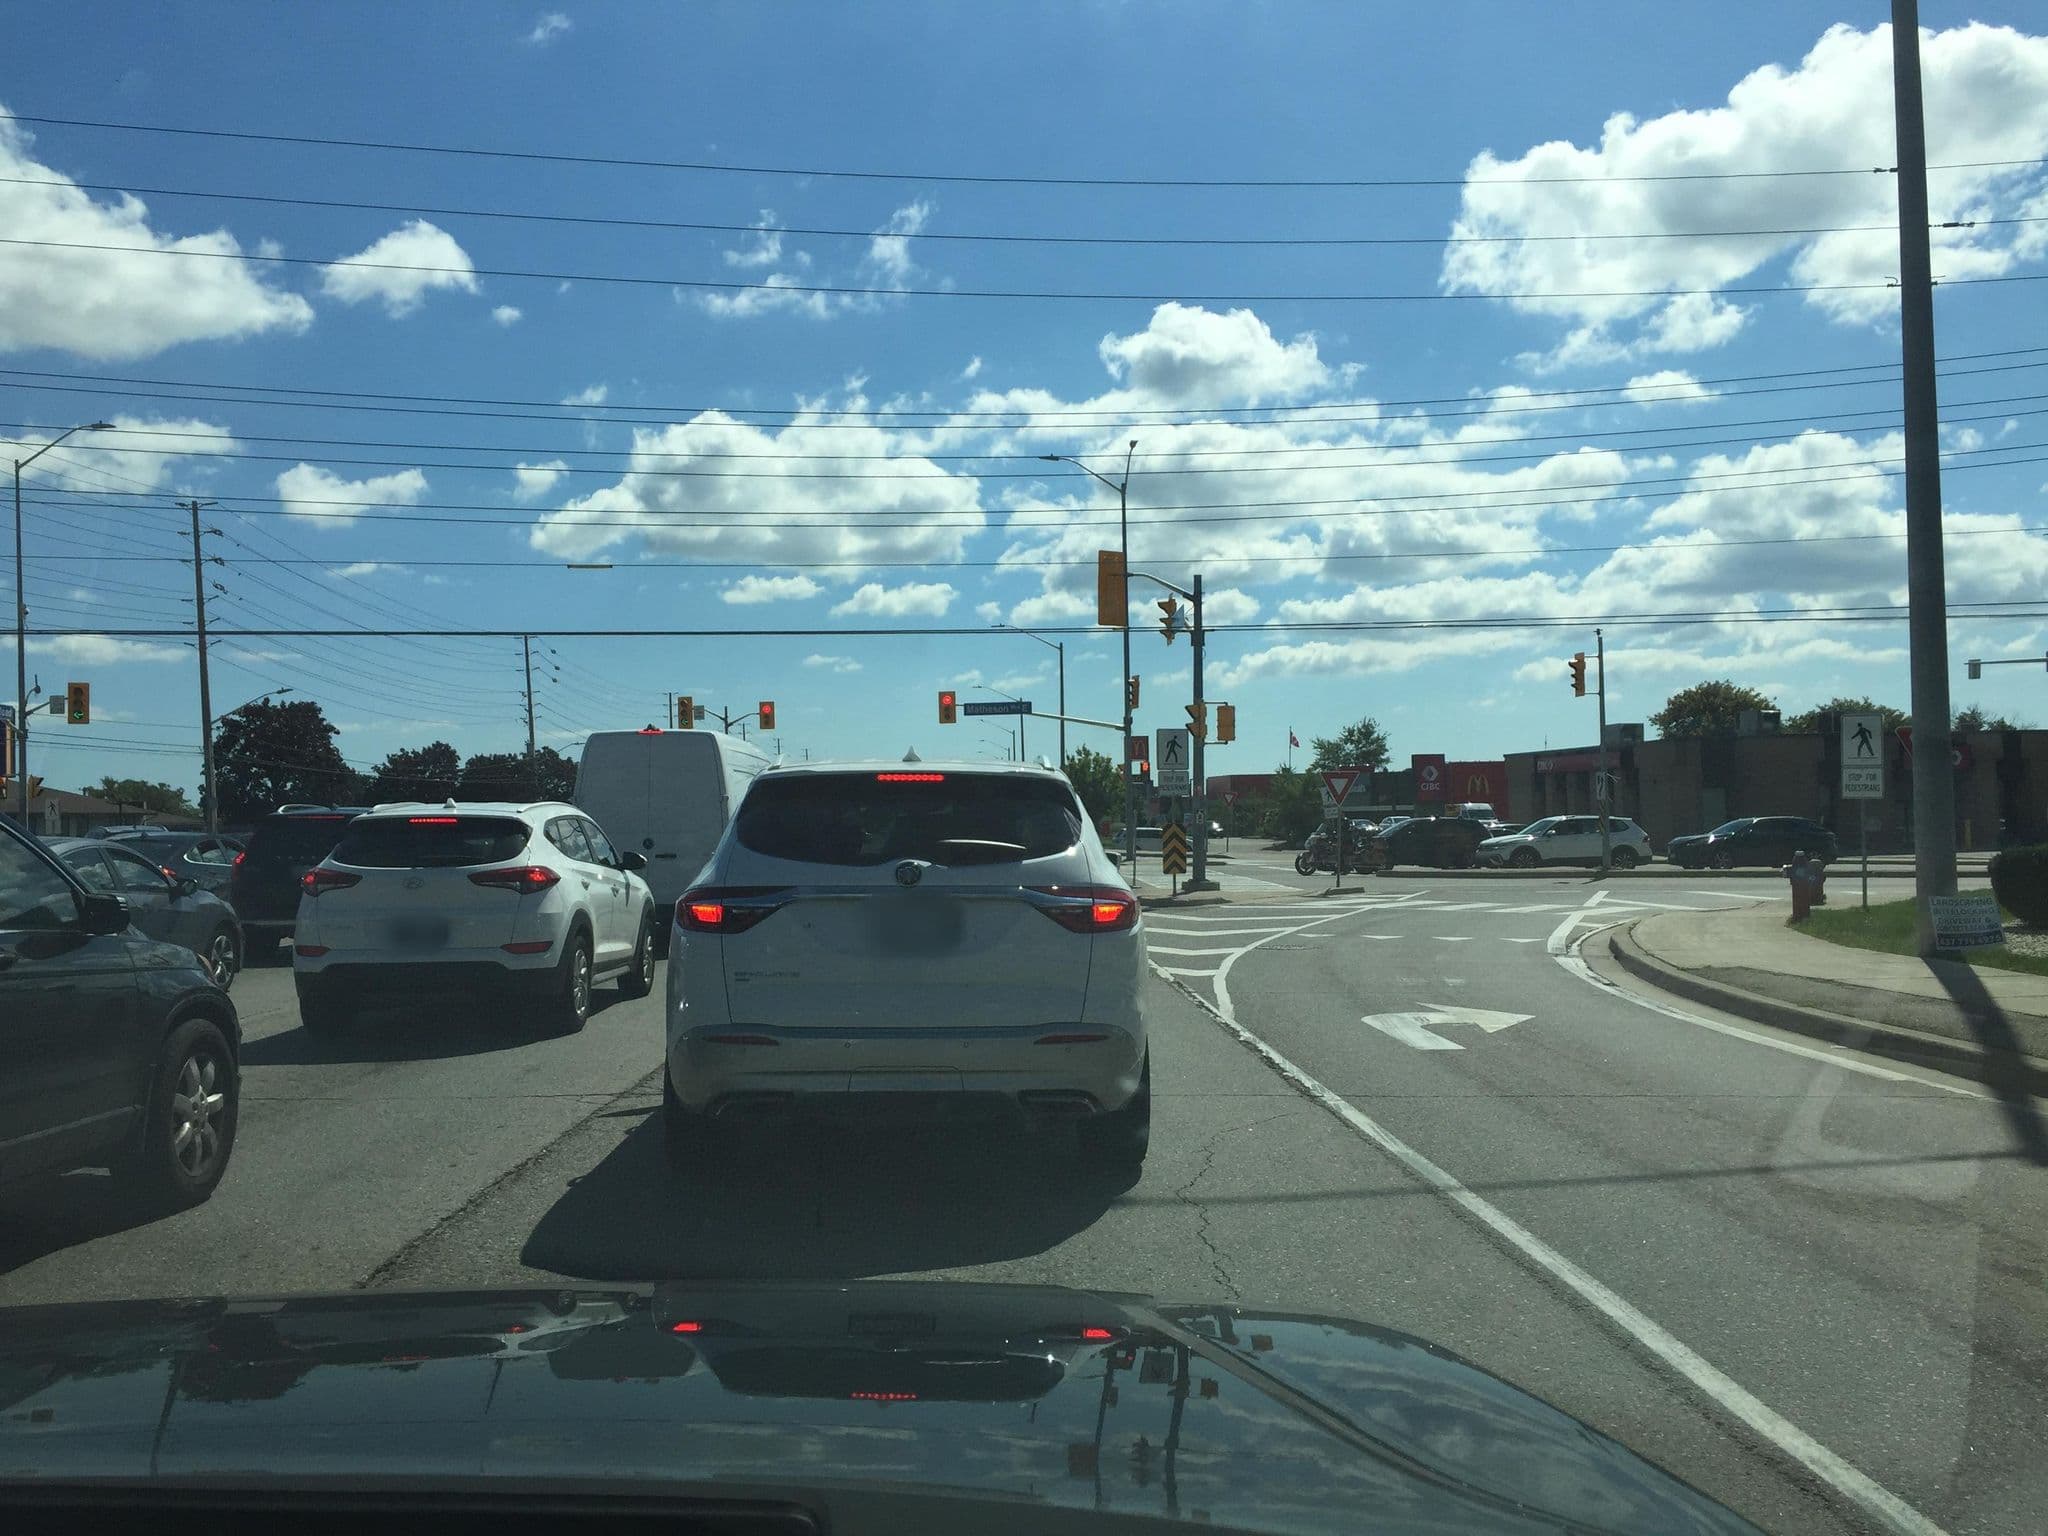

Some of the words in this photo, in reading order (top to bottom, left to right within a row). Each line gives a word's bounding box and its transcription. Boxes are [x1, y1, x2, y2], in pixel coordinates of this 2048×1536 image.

[966, 703, 1009, 715] Matheson
[1848, 773, 1863, 781] STOP
[1420, 782, 1440, 791] CIBC
[1844, 783, 1881, 792] PEDESTRIANS
